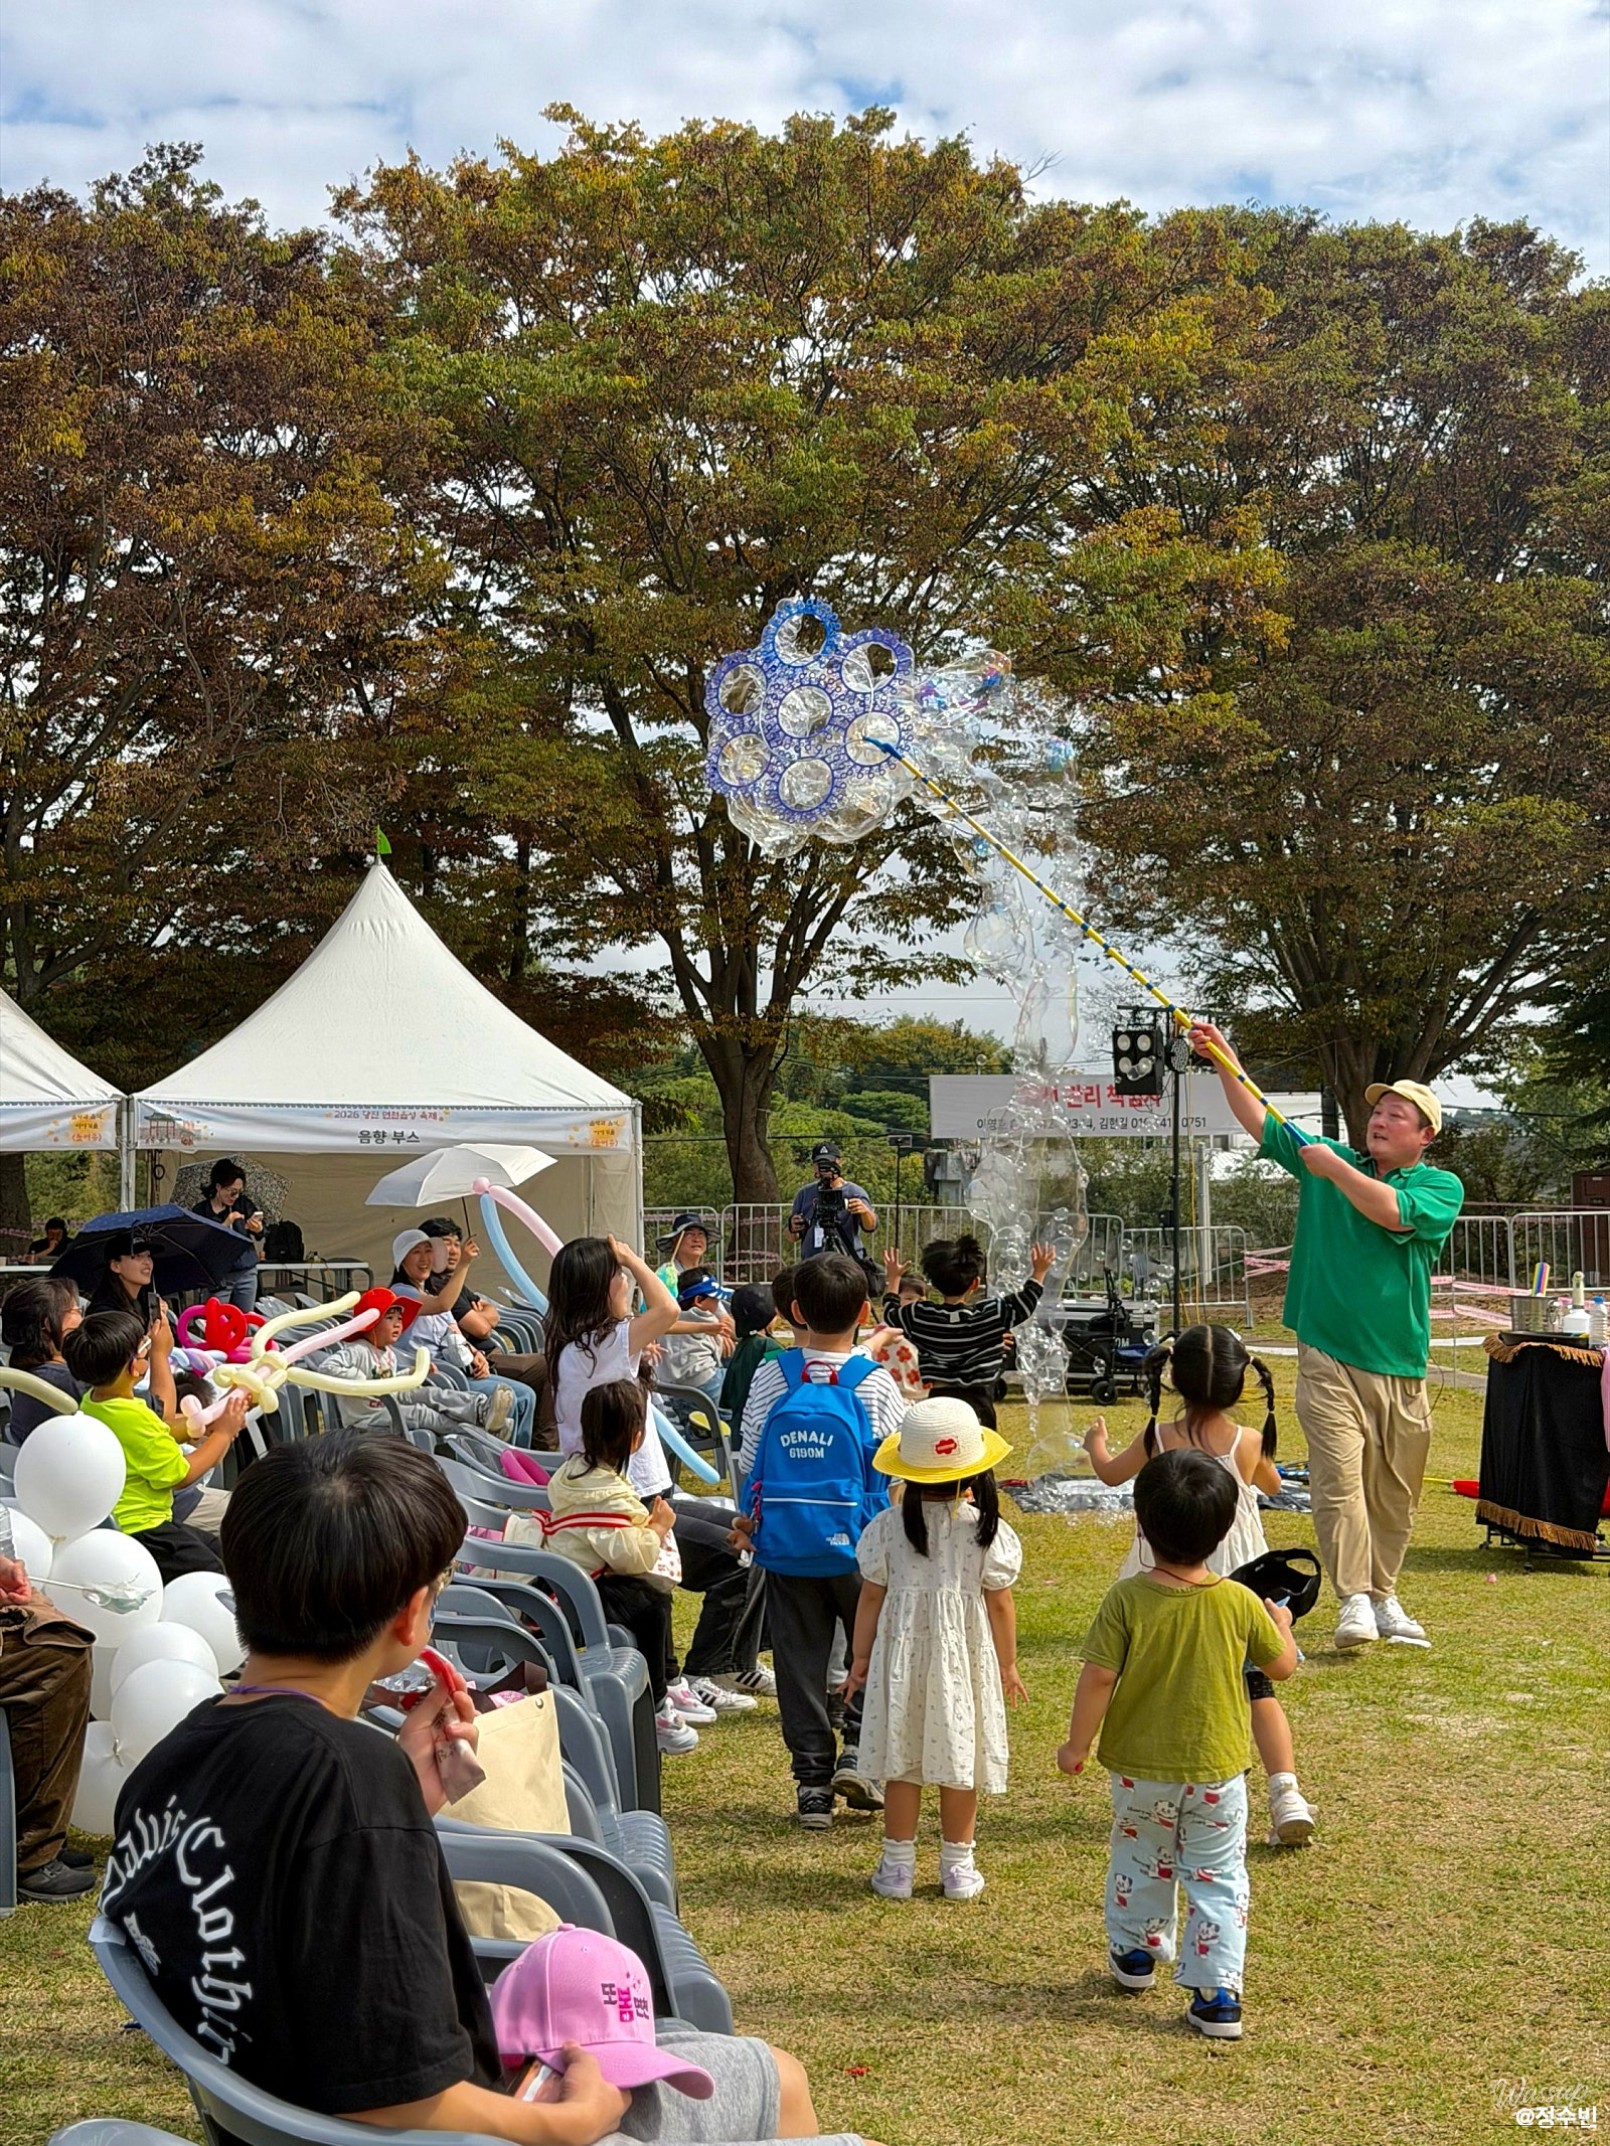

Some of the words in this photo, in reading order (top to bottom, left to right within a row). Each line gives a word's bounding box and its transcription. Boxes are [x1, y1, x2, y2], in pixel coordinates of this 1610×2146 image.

[334, 1110, 360, 1119] 2026
[358, 1130, 388, 1144] 음향
[391, 1130, 421, 1144] 부스
[780, 1430, 834, 1447] DENALI
[789, 1448, 825, 1459] 6190M
